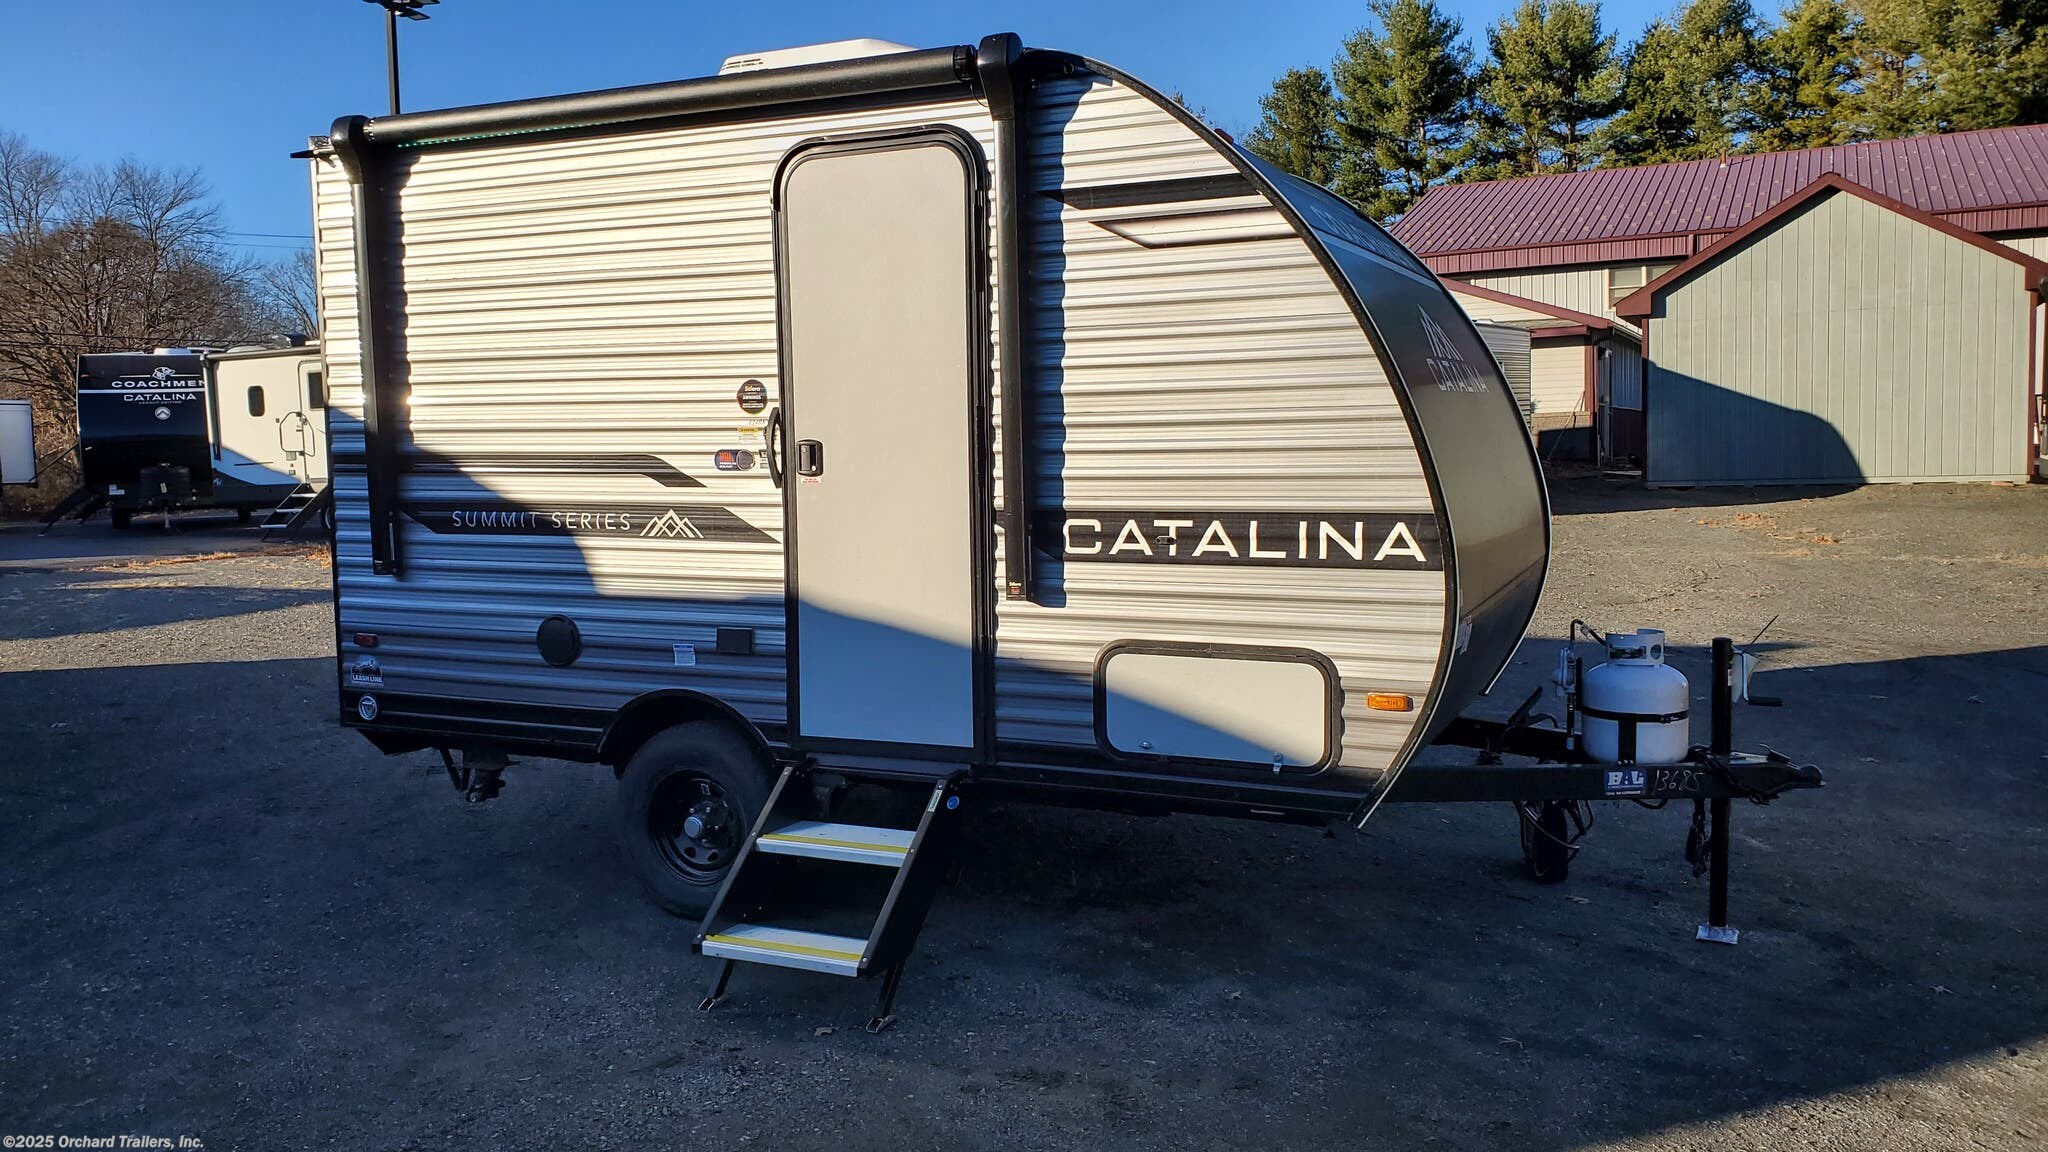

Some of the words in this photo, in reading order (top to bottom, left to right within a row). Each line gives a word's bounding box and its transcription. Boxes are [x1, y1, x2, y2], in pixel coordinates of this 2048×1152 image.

[1426, 358, 1490, 393] CATALINA
[123, 393, 197, 402] CATALINA
[452, 511, 539, 528] SUMMIT
[551, 512, 631, 530] SERIES
[1061, 518, 1427, 562] CATALINA
